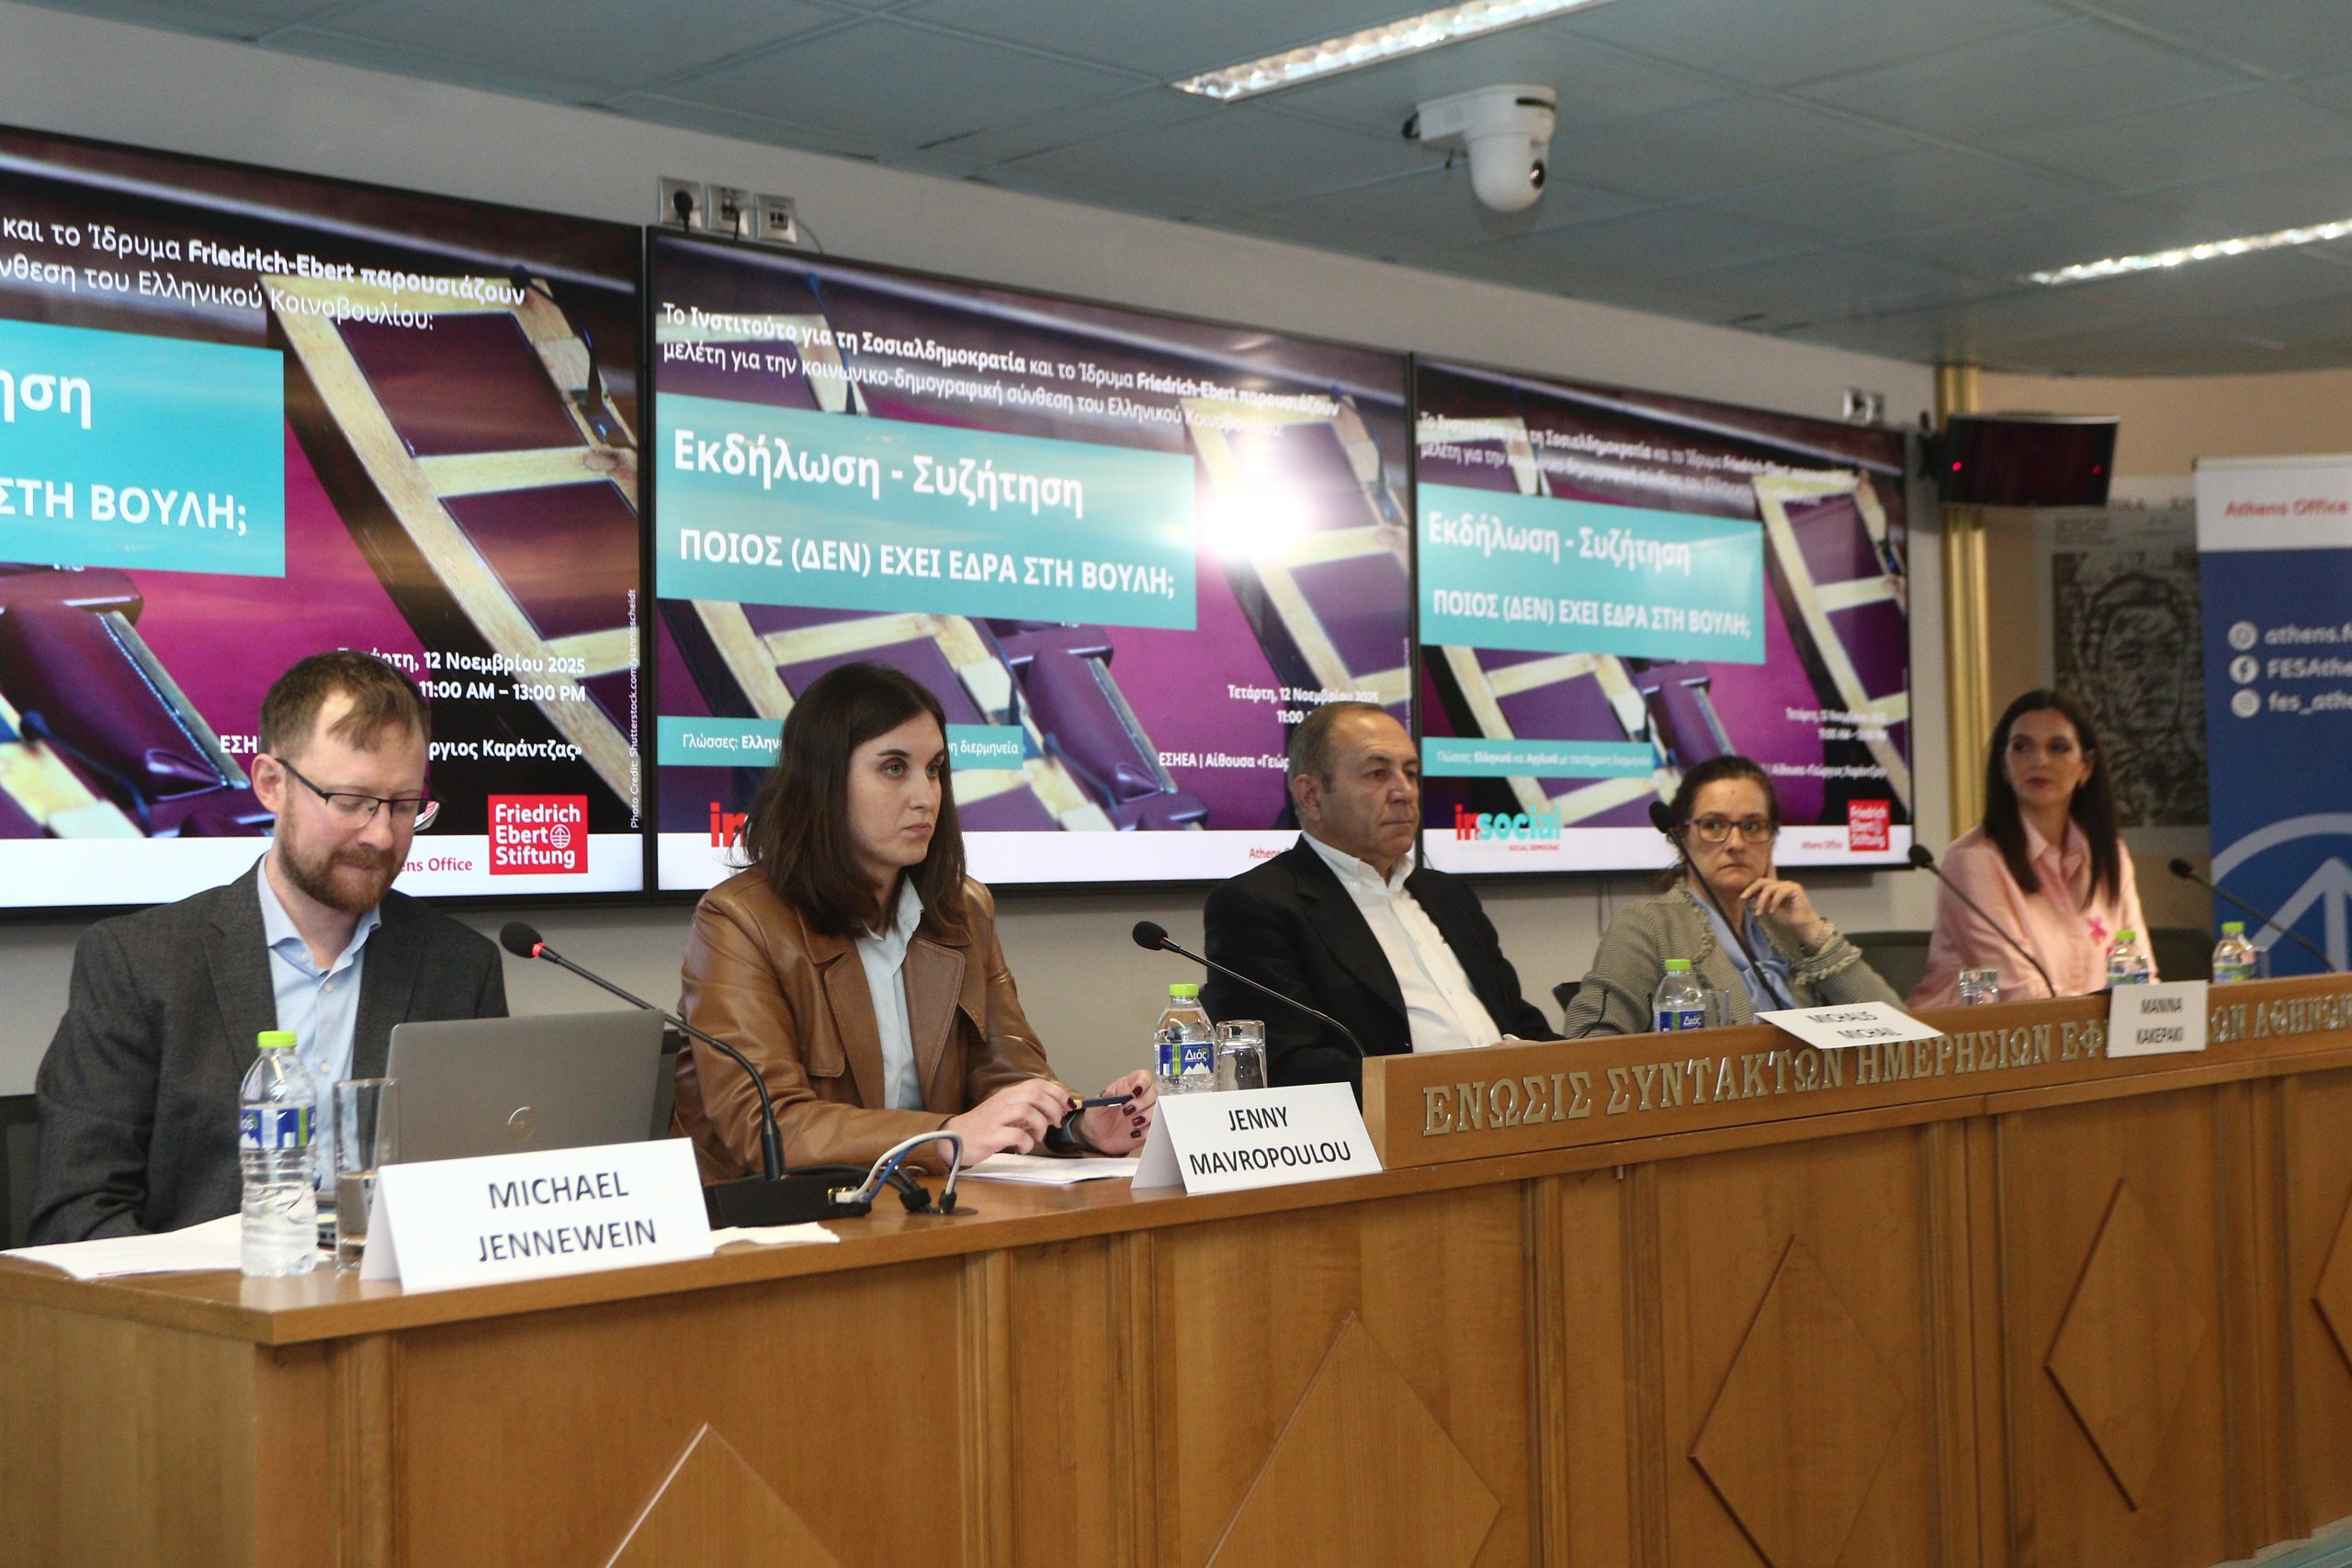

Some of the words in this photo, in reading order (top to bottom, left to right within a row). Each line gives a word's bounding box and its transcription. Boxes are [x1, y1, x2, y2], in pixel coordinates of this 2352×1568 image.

[4, 217, 44, 243] και
[51, 223, 81, 247] το
[88, 222, 181, 262] Ίδρυμα
[188, 239, 354, 283] Friedrich-Ebert
[360, 267, 526, 306] παρουσιάζουν
[85, 268, 130, 292] του
[139, 270, 263, 309] Ελληνικού
[270, 288, 434, 331] Κοινοβουλίου:
[662, 302, 685, 325] Το
[690, 306, 797, 342] Ινστιτούτο
[801, 326, 831, 348] για
[836, 332, 857, 355] τη
[863, 332, 1025, 372] Σοσιαλδημοκρατία
[1030, 359, 1054, 378] και
[1057, 363, 1075, 380] το
[1078, 361, 1133, 389] Ίδρυμα
[1136, 371, 1236, 402] Friedrich-Ebert
[663, 340, 726, 372] μελέτη
[731, 350, 761, 373] για
[765, 353, 797, 378] την
[802, 360, 1003, 406] κοινωνικο-δημογραφική
[1007, 383, 1073, 414] σύνθεση
[1077, 395, 1102, 413] του
[1108, 396, 1182, 424] Ελληνικού
[674, 429, 880, 500] Εκδήλωση
[913, 455, 1083, 519] Συζήτηση
[90, 483, 247, 536] ΒΟΥΛΗ;
[1429, 511, 1560, 564] Εκδήλωση
[1578, 526, 1690, 575] Συζήτηση
[680, 528, 783, 567] ΠΟΙΟΣ
[791, 537, 871, 578] (ΔΕΝ)
[880, 545, 940, 578] ΕΧΕΙ
[949, 550, 1017, 584] ΕΔΡΑ
[1023, 557, 1074, 588] ΣΤΗ
[1081, 561, 1175, 600] ΒΟΥΛΗ;
[1433, 589, 1499, 618] ΠΟΙΟΣ
[1503, 594, 1555, 626] (ΔΕΝ)
[1559, 599, 1599, 626] ΕΧΕΙ
[1603, 603, 1648, 628] ΕΔΡΑ
[1653, 606, 1684, 632] ΣΤΗ
[1689, 610, 1751, 638] ΒΟΥΛΗ;
[2264, 623, 2352, 646] athens.f
[423, 651, 441, 670] 12
[446, 652, 543, 676] Νοεμβρίου
[548, 657, 585, 674] 2025
[419, 681, 461, 698] 11:00
[466, 682, 494, 700] AM
[513, 683, 556, 701] 13:00
[560, 685, 586, 702] PM
[1227, 684, 1278, 705] Τετάρτη,
[1279, 687, 1291, 702] 12
[1276, 710, 1304, 724] 11:00
[482, 738, 582, 761] Καράντζας»
[683, 733, 738, 752] Γλώσσες:
[960, 739, 1018, 757] διερμηνεία
[1159, 752, 1197, 768] ΕΣΗΕΑ
[1204, 751, 1255, 768] Αίθουσα
[494, 803, 581, 824] Friedrich
[630, 797, 640, 829] Photo
[495, 825, 548, 844] Ebert
[428, 857, 473, 873] Office
[495, 845, 577, 869] Stiftung
[1184, 1048, 1207, 1062] Διός
[1422, 1071, 1593, 1137] ΕΝΩΣΙΣ
[1606, 1046, 1845, 1116] ΣΥΝΤΑΚΤΩΝ
[1855, 1021, 2052, 1086] ΗΜΕΡΗΣΙΩΝ
[1227, 1106, 1288, 1132] JENNY
[1189, 1141, 1351, 1176] MAVROPOULOU
[488, 1171, 629, 1210] MICHAEL
[479, 1218, 657, 1262] JENNEWEIN
